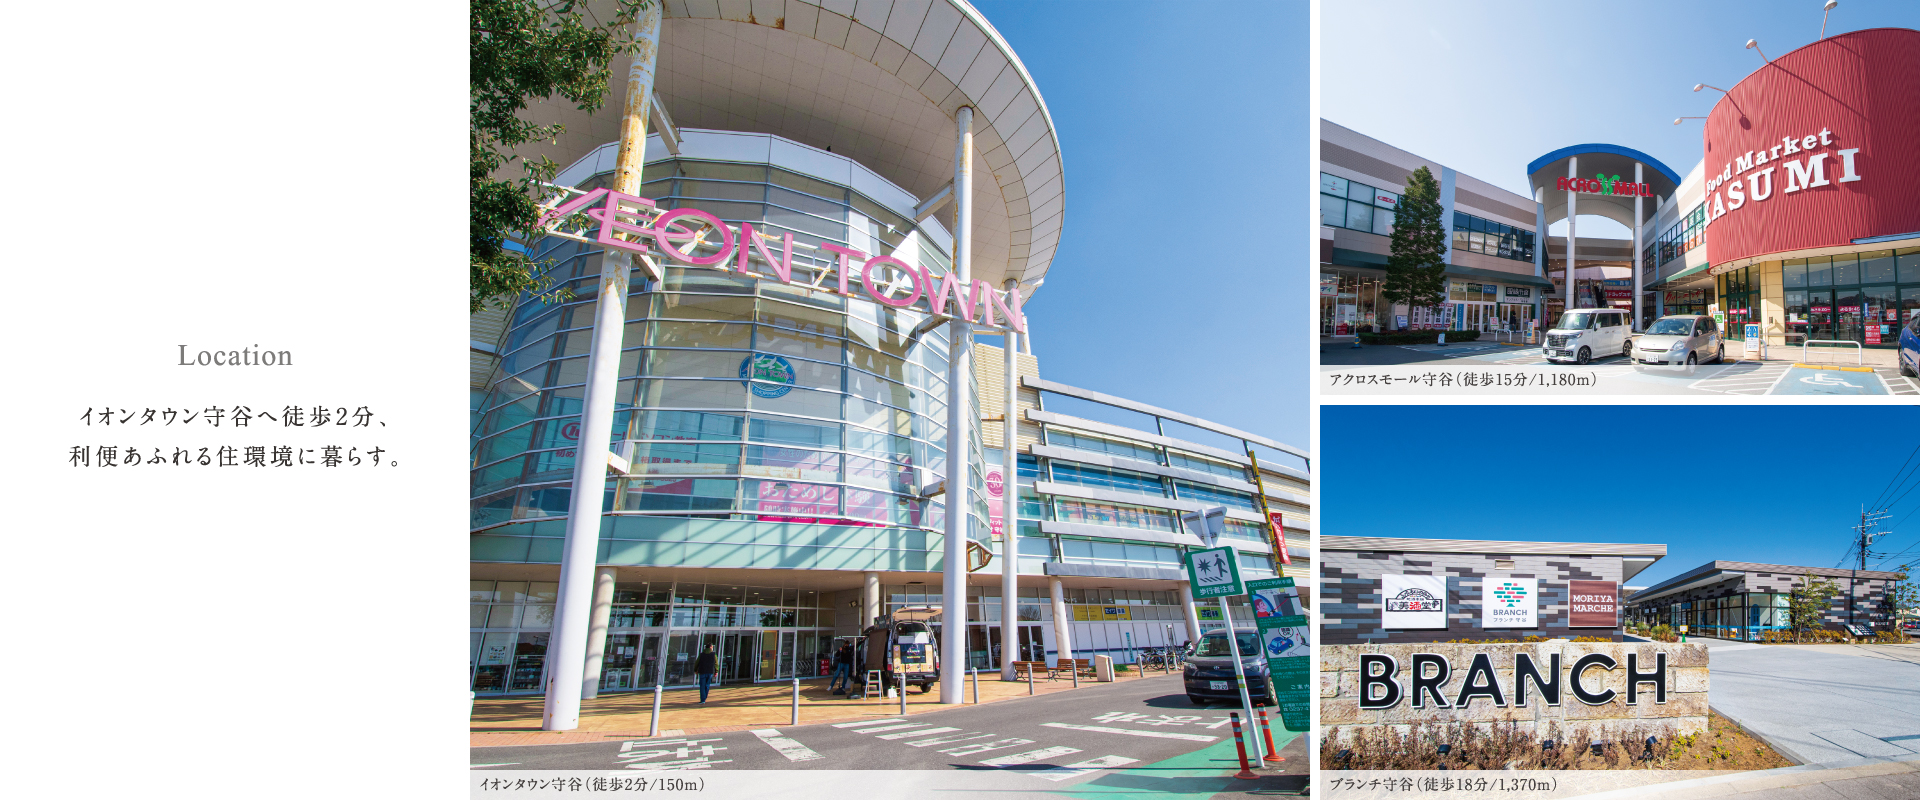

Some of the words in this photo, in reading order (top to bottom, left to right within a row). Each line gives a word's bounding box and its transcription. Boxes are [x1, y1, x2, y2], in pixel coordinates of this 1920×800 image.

[1706, 162, 1733, 197] Food
[1735, 126, 1832, 175] Market
[1613, 180, 1654, 198] MALL
[820, 241, 1025, 334] TOWN
[762, 481, 871, 505] おためし験
[1199, 585, 1236, 595] 歩行者注意
[1572, 594, 1614, 603] MORIYA
[1572, 604, 1614, 613] MARCHE
[1358, 652, 1668, 709] BRANCH
